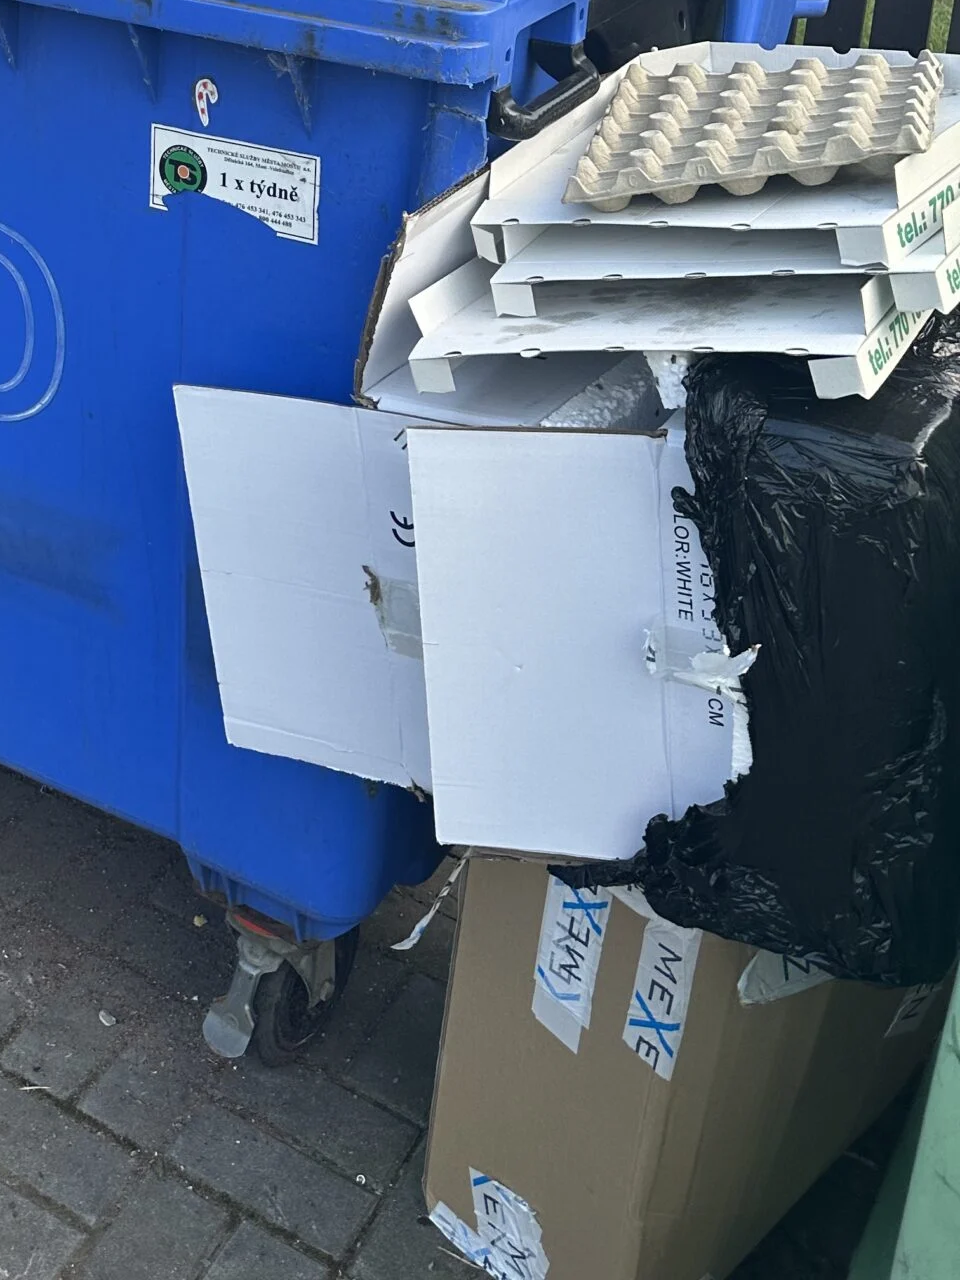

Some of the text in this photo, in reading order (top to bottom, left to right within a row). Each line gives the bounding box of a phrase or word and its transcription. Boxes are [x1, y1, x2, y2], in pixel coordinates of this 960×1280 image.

[220, 172, 300, 203] 1 x týdně
[896, 206, 928, 249] tel.:
[868, 310, 910, 376] tel.: 770
[673, 514, 695, 622] LOR:WHITE
[708, 697, 726, 727] CM
